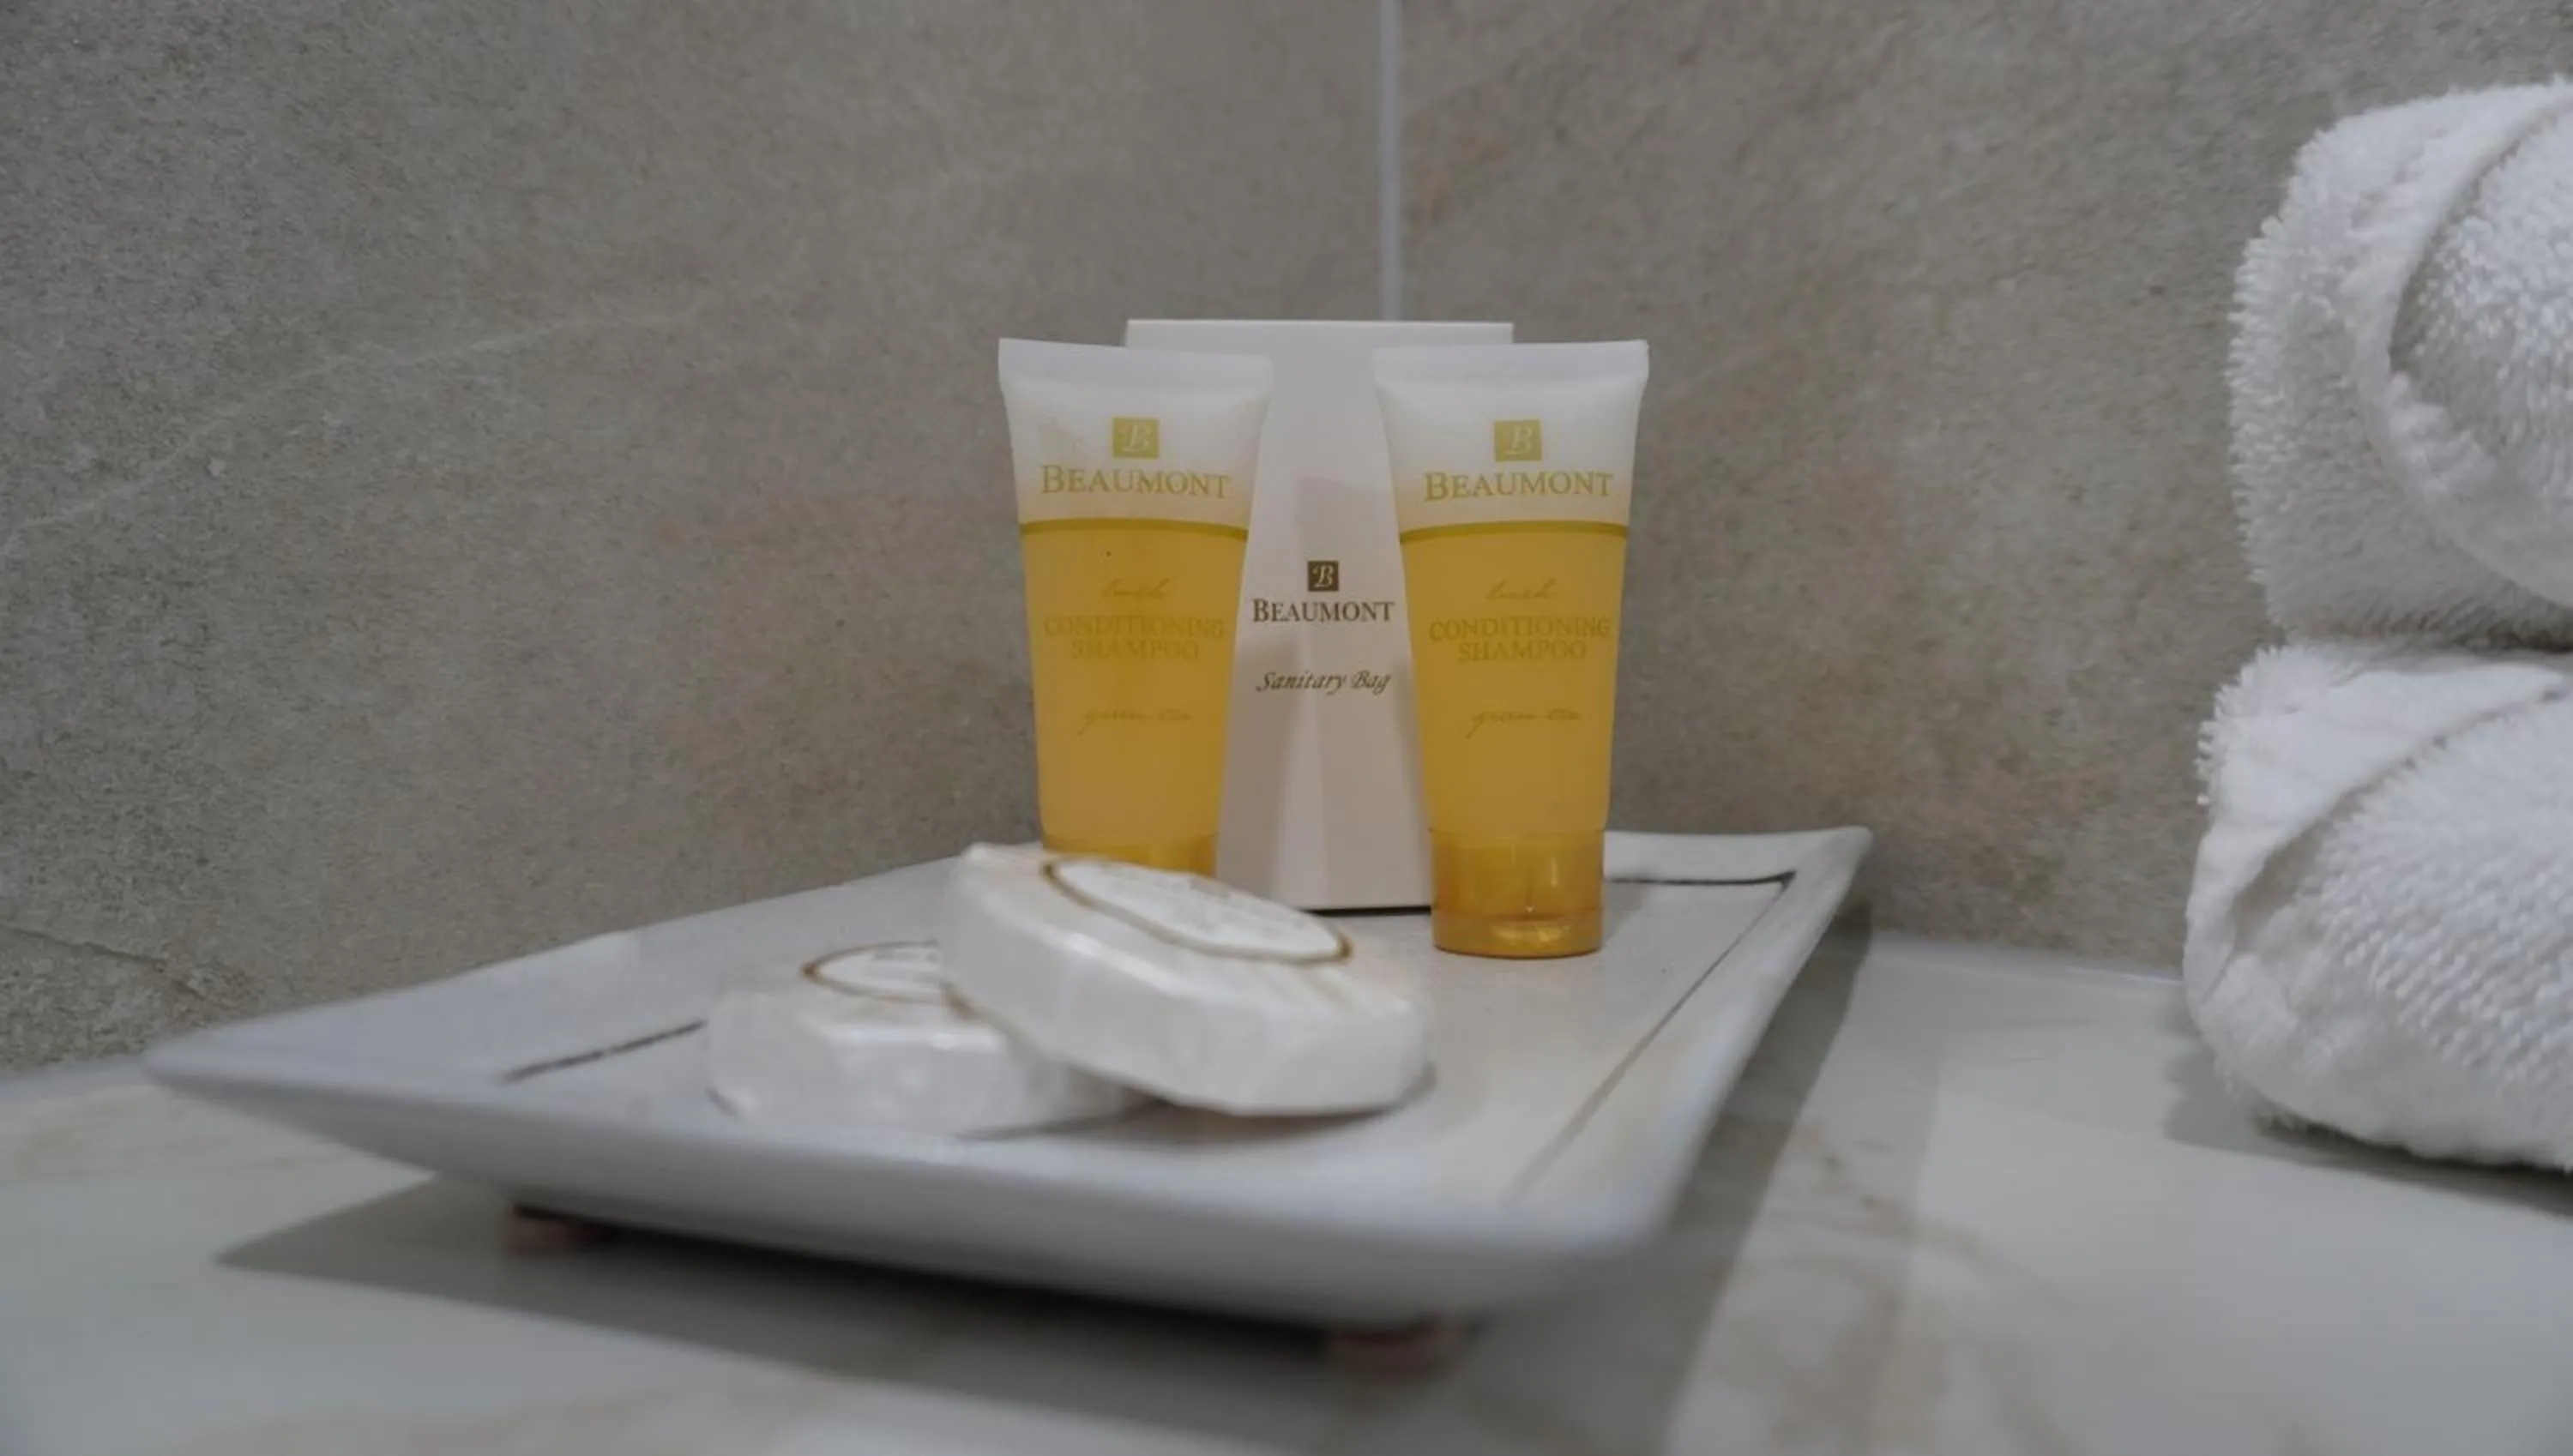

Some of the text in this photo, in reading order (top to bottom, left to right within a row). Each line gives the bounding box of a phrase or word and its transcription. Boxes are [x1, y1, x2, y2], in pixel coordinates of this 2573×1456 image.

[1041, 465, 1230, 499] BEAUMONT
[1424, 471, 1614, 502] BEAUMONT
[1253, 599, 1395, 623] BEAUMONT
[1044, 615, 1224, 640] CONDITIONING
[1429, 616, 1612, 641] CONDITIONING
[1071, 639, 1199, 661] SHAMPOO
[1458, 641, 1588, 663] SHAMPOO
[1256, 670, 1391, 695] Sanitary Bag
